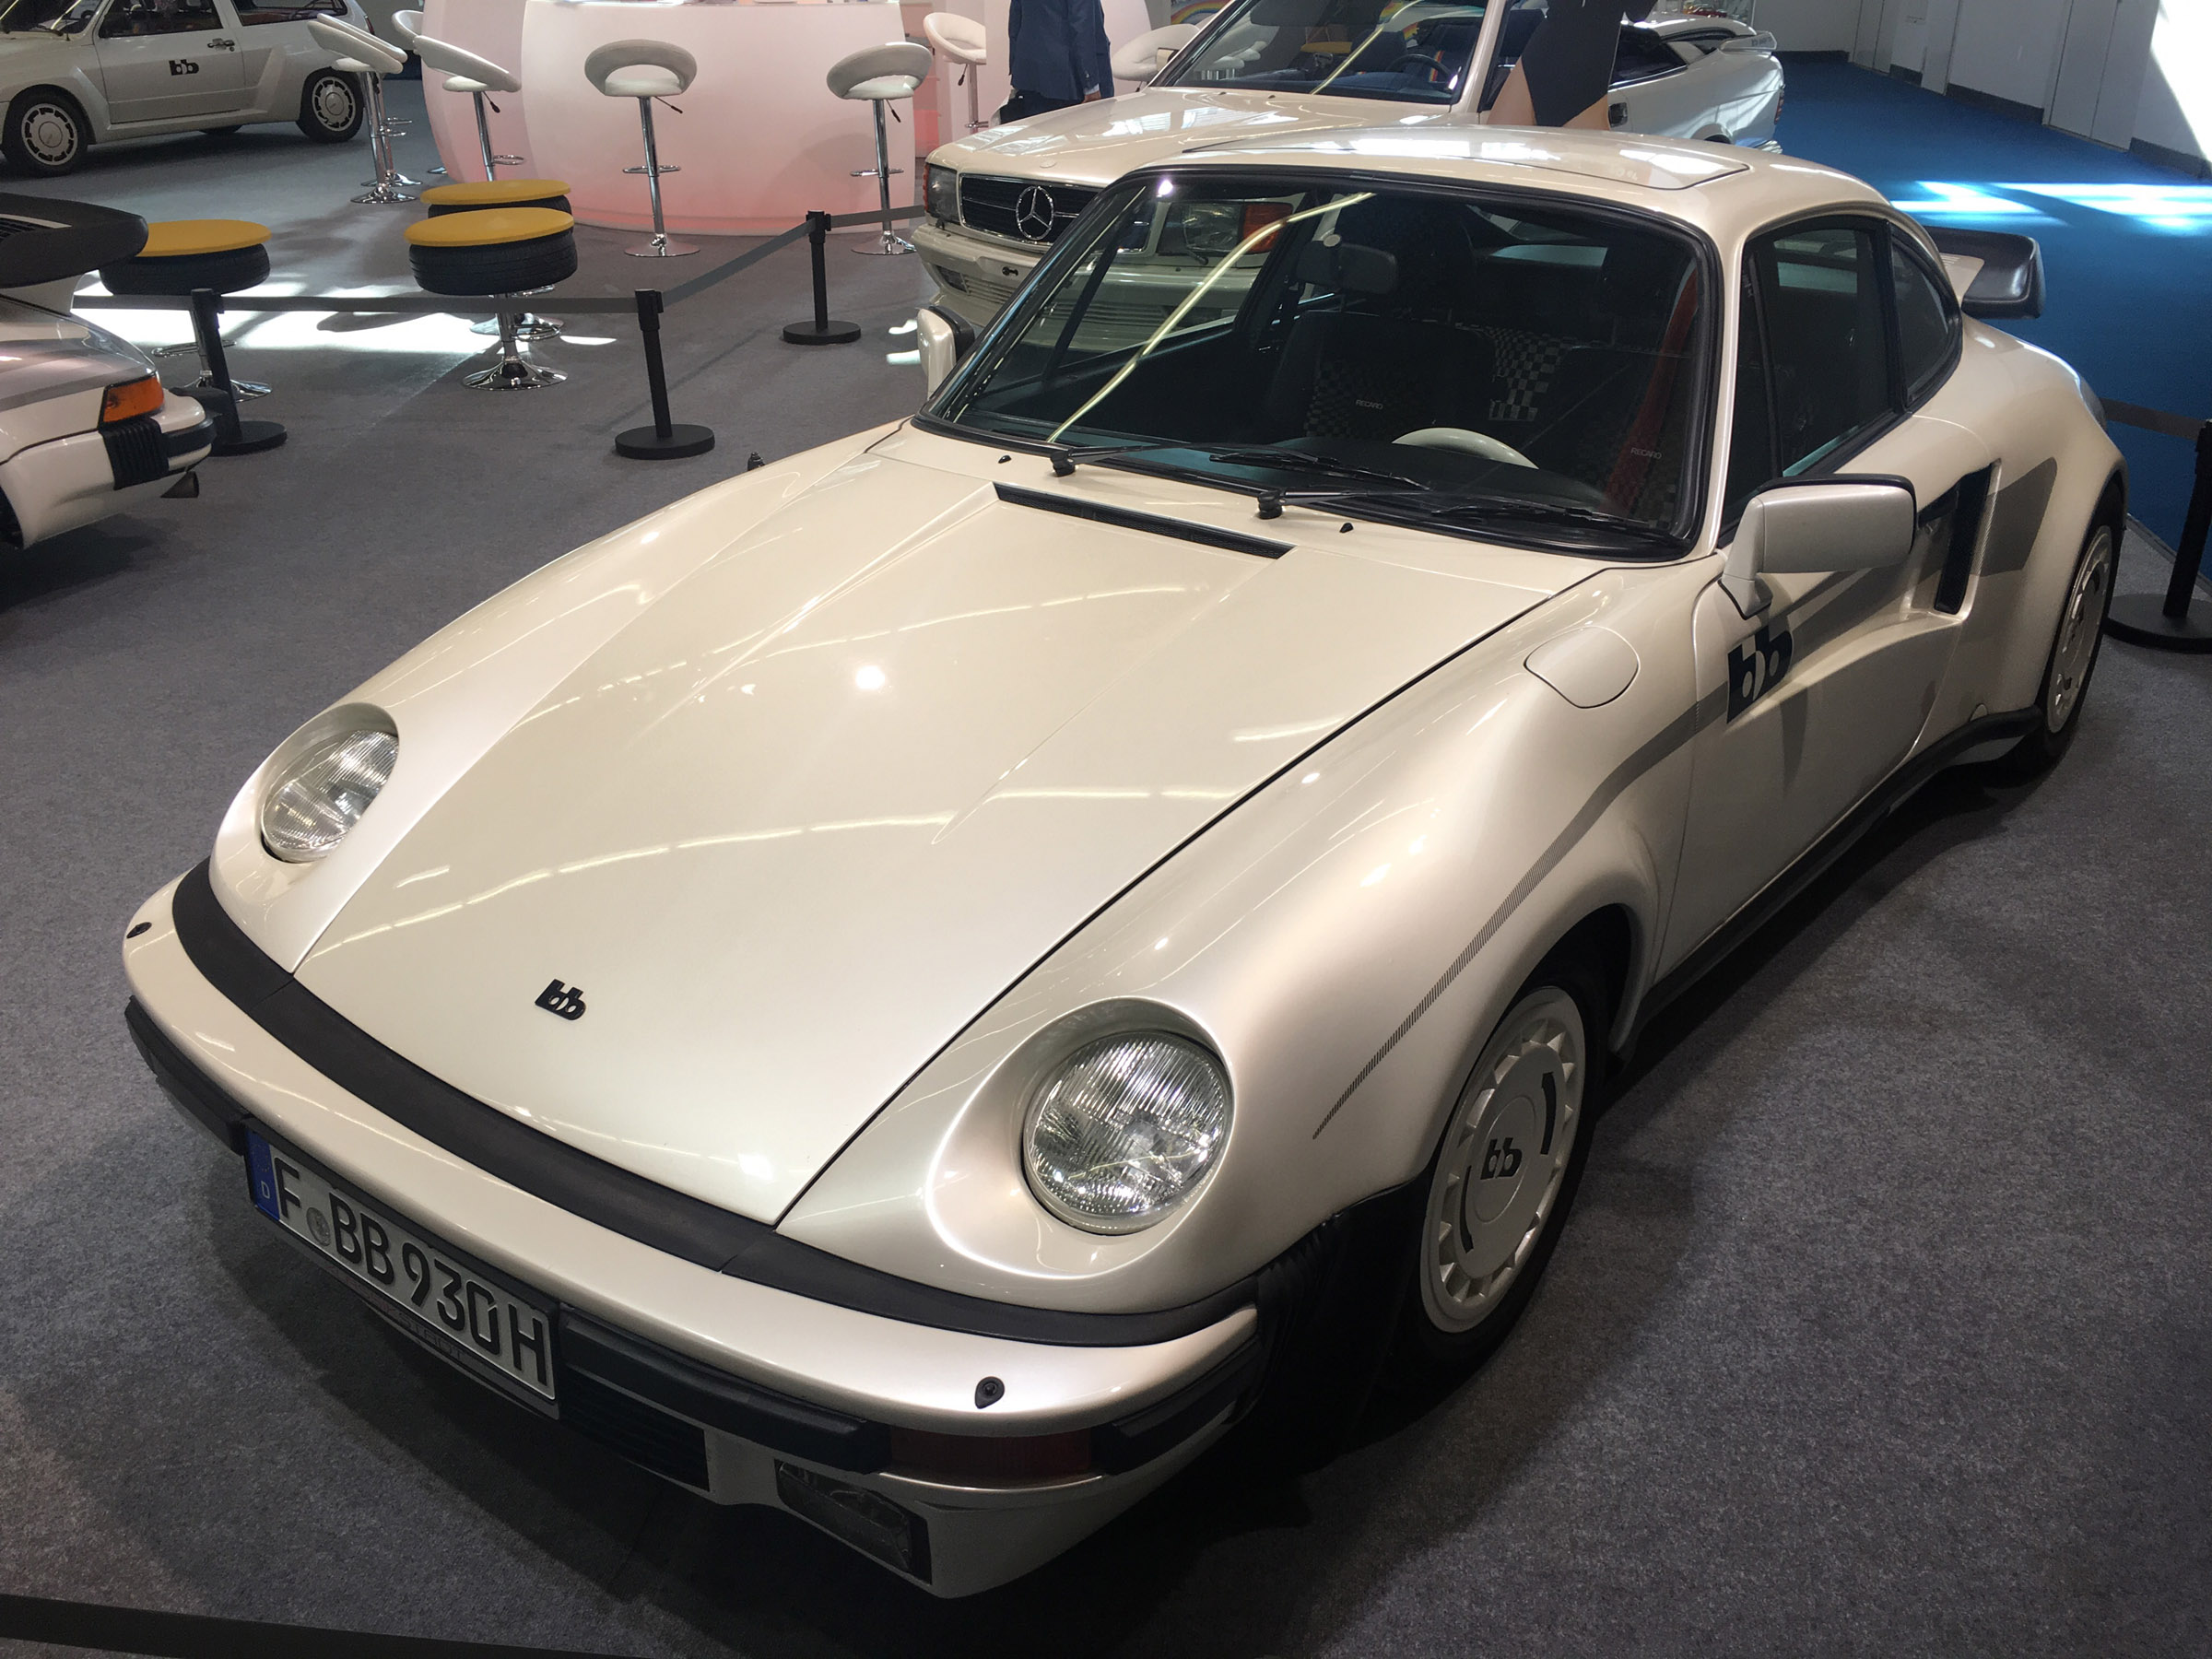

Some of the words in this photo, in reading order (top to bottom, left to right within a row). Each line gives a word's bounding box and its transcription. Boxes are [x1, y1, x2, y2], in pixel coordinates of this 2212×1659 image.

[169, 59, 199, 76] bb
[1355, 399, 1384, 410] RECARO
[1630, 447, 1662, 460] RECARO
[1726, 625, 1793, 724] bb
[535, 978, 586, 1020] bb
[1480, 1136, 1523, 1181] bb
[260, 1180, 271, 1200] D
[274, 1157, 300, 1218] F
